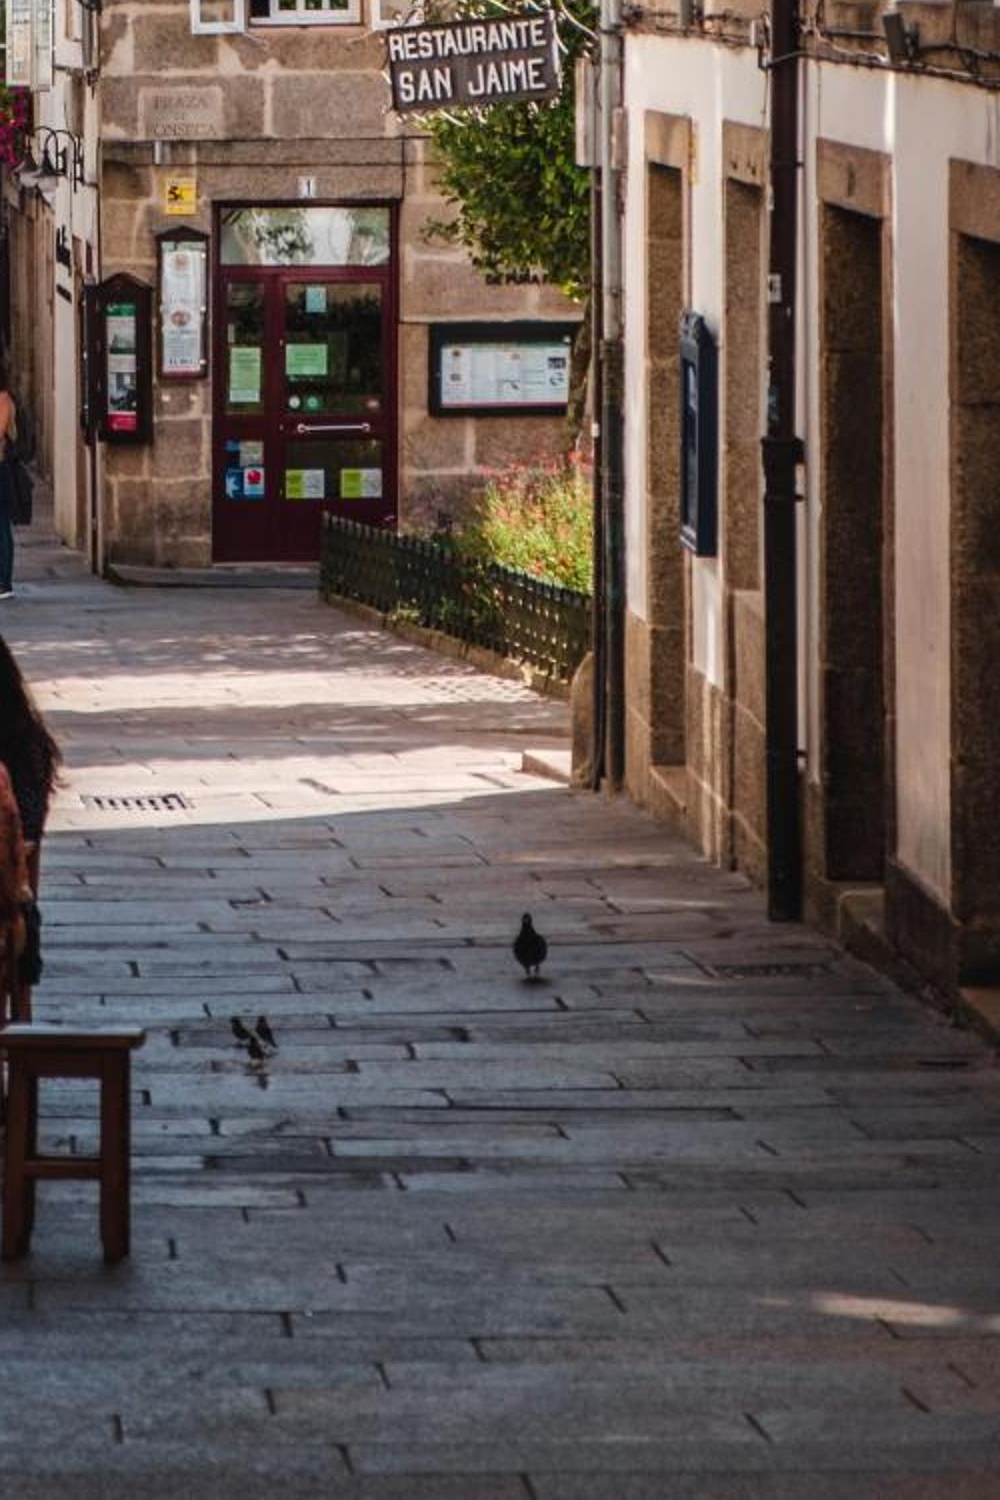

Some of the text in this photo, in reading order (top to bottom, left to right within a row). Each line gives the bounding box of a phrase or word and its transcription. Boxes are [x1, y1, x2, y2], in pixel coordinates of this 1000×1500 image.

[388, 19, 547, 62] RESTAURANTE
[400, 57, 546, 103] SAN JAIME
